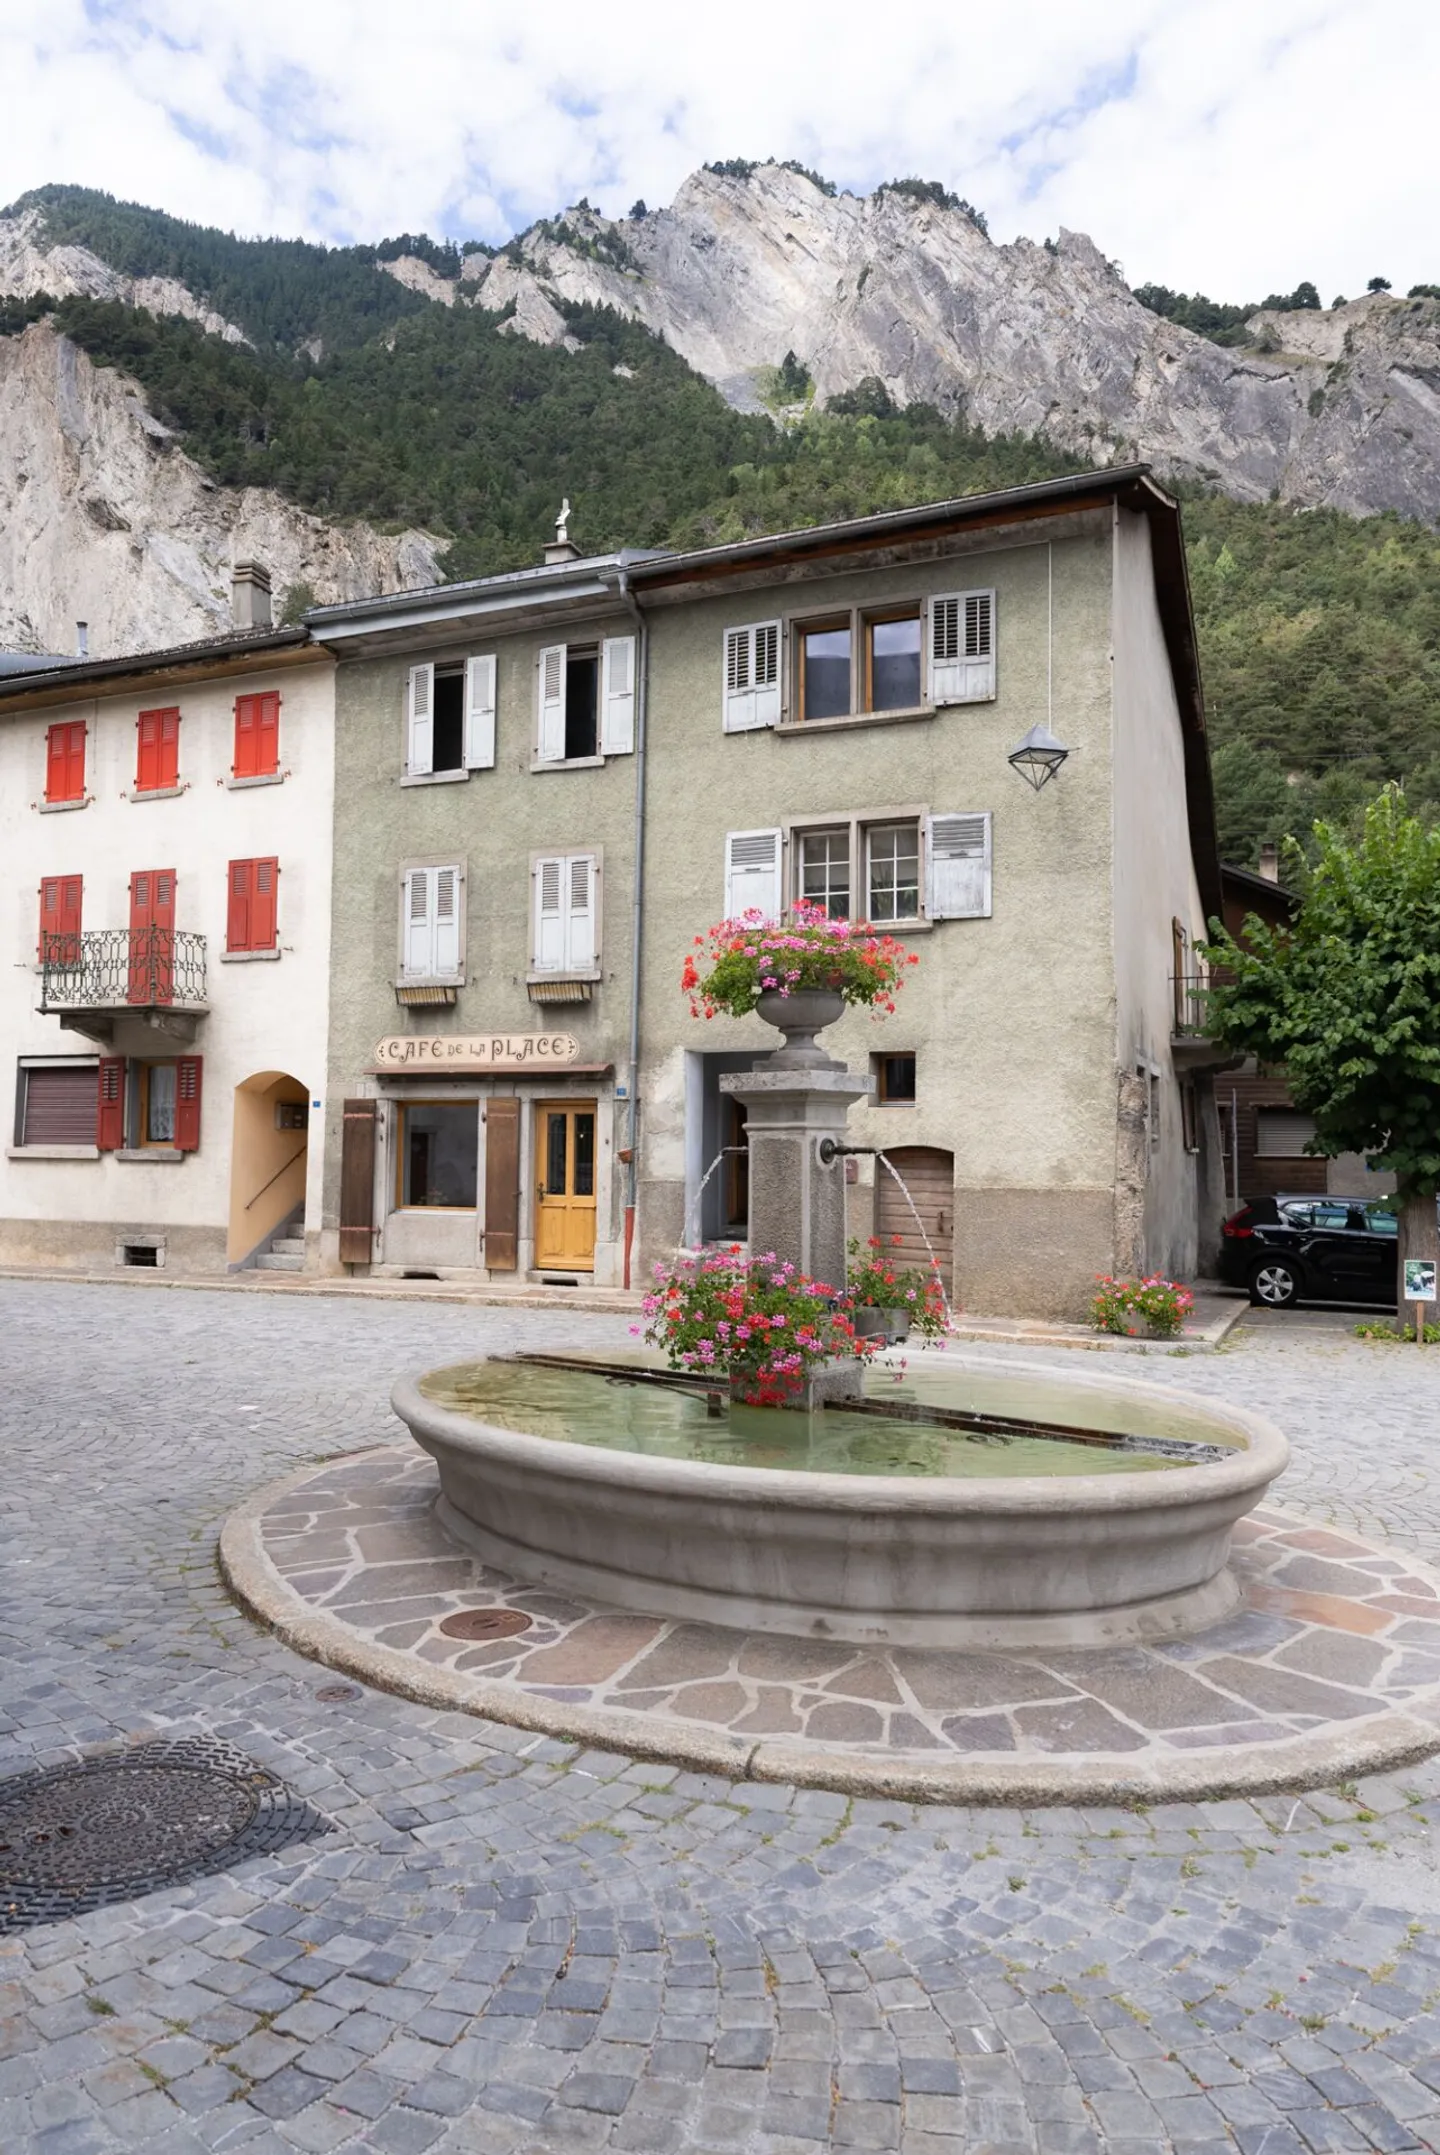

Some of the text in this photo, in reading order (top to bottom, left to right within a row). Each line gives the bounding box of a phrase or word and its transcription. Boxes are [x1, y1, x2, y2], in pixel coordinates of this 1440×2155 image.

[388, 1036, 443, 1062] CAFÉ
[469, 1043, 486, 1057] LA
[491, 1037, 565, 1061] PLACE
